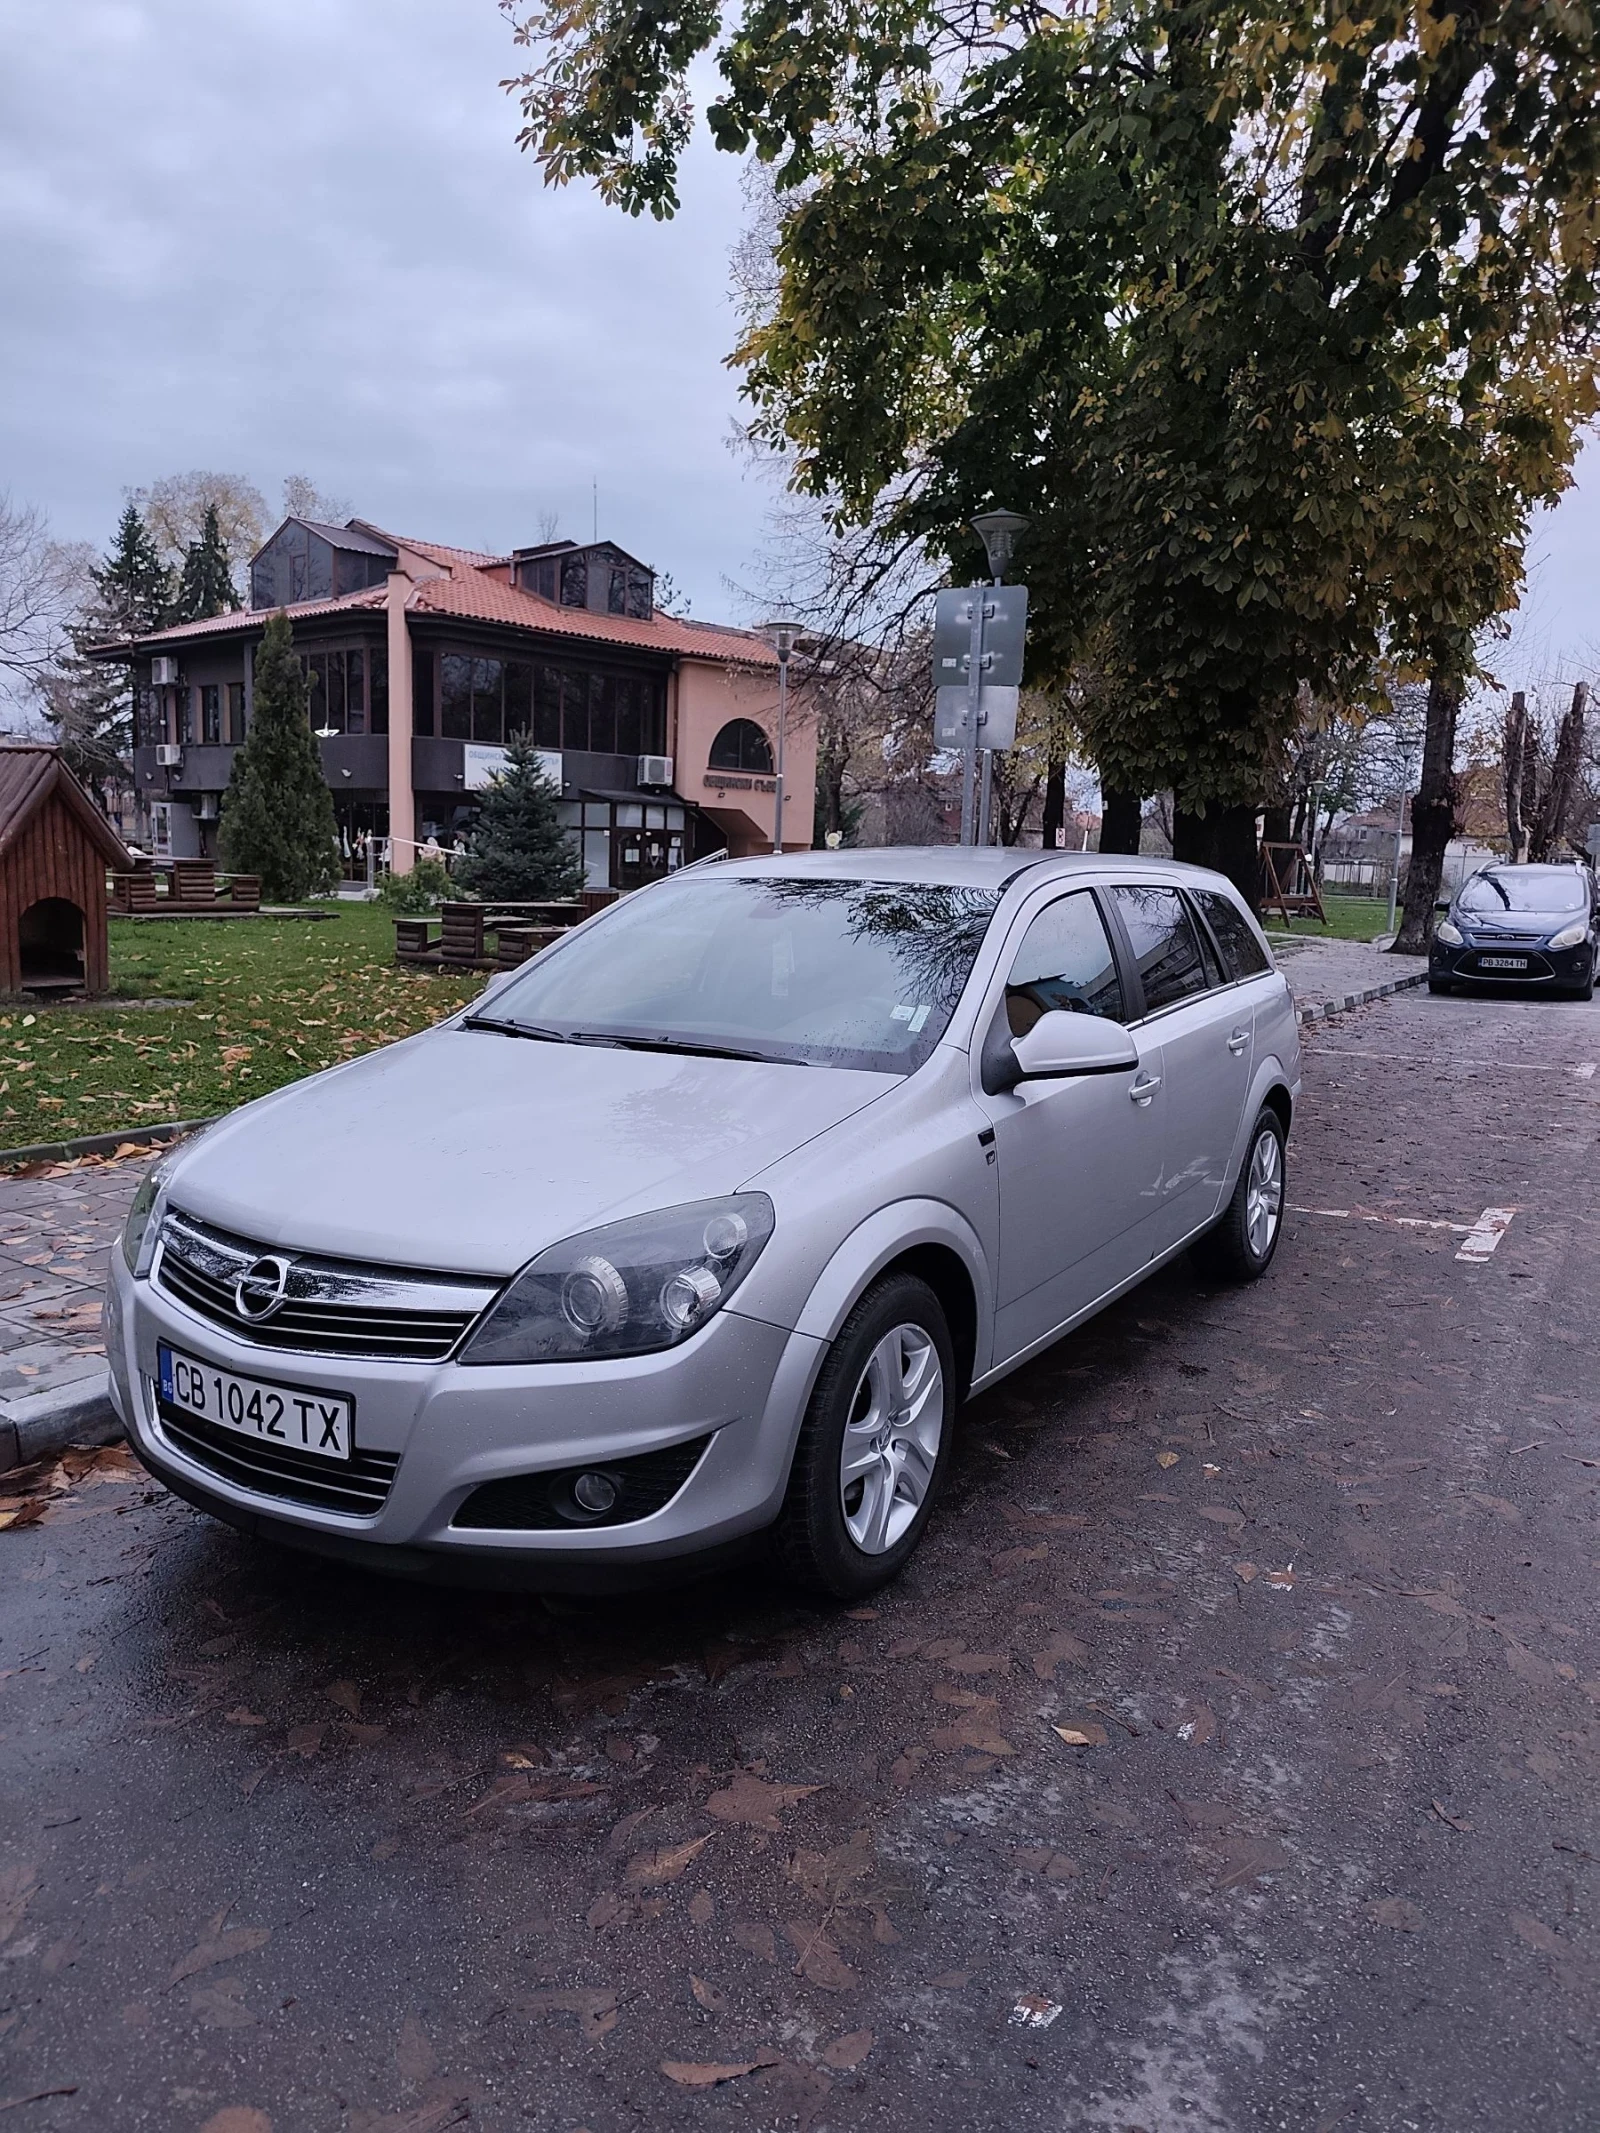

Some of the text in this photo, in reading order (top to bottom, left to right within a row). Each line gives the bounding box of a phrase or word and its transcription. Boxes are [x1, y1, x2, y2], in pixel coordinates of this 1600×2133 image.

[468, 750, 504, 761] ОБЩИНСК
[1482, 958, 1494, 967] PB
[1494, 959, 1514, 968] 3284
[1516, 960, 1526, 968] TH
[162, 1379, 173, 1394] BG
[175, 1361, 341, 1452] CB 1042 TX
